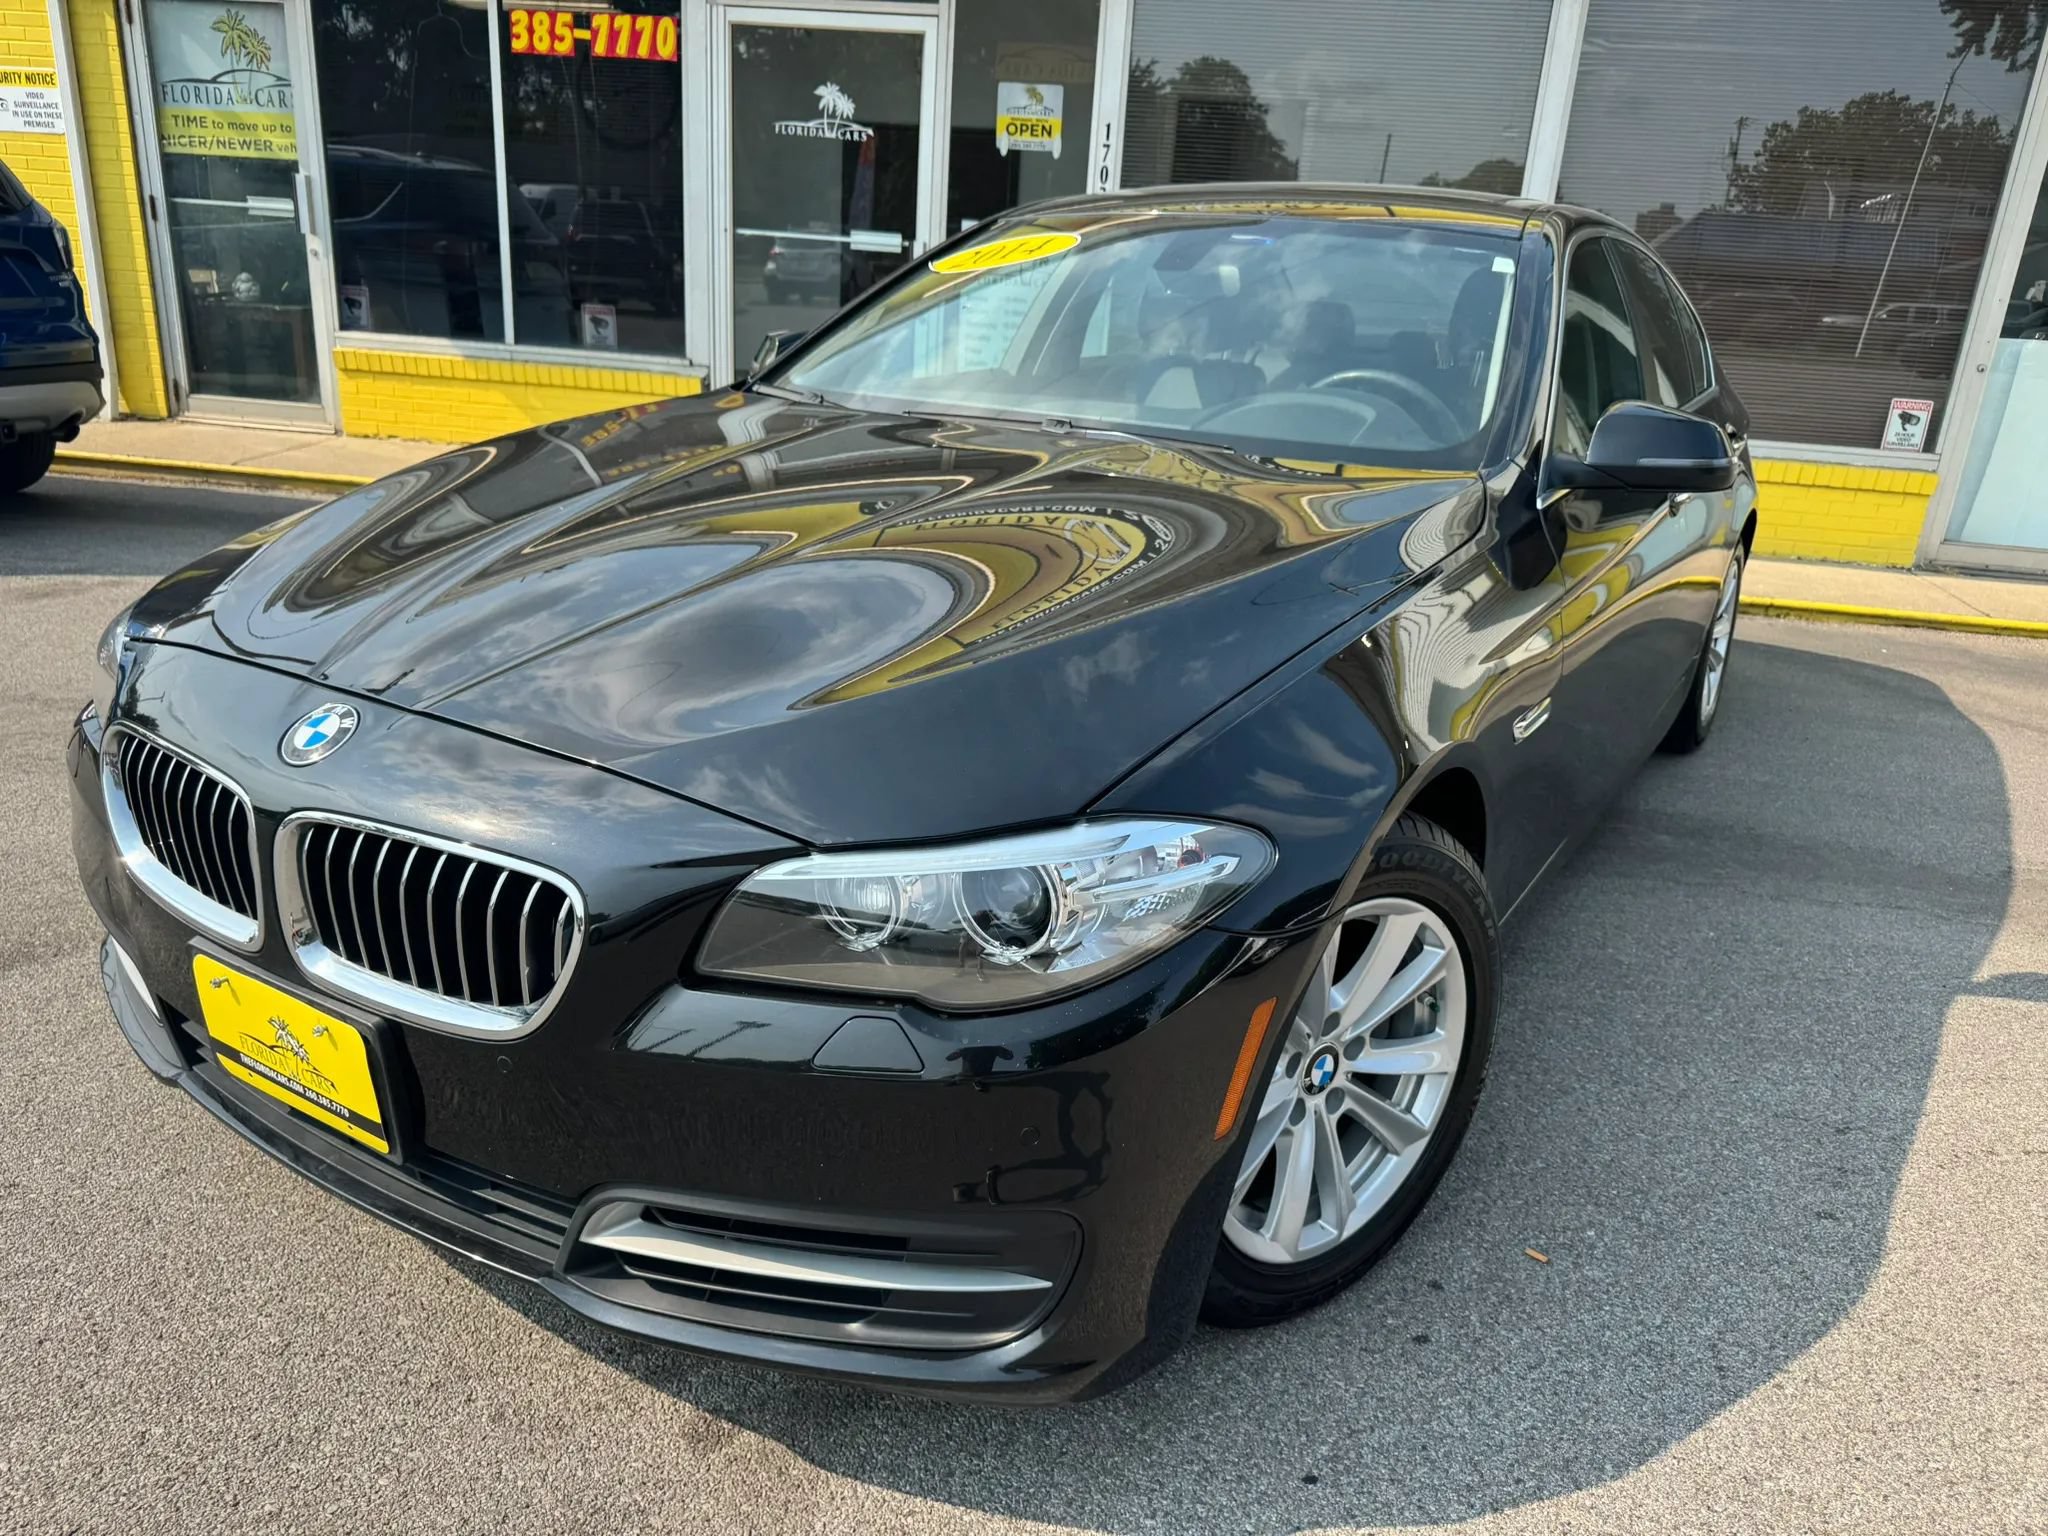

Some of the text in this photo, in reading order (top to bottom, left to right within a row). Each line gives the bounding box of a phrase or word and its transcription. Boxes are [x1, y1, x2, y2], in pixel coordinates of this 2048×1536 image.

[511, 9, 677, 60] 385-7770
[25, 72, 56, 86] NOTICE
[25, 91, 45, 100] VIDEO
[161, 83, 294, 109] FLORIDA CAR
[13, 100, 59, 110] SURVEILLANCE
[12, 110, 63, 120] IN USE ON THESE
[23, 119, 56, 129] PREMISES
[171, 114, 292, 134] TIME to move up to
[774, 123, 868, 142] FLORIDA CARS
[1006, 122, 1052, 139] OPEN
[161, 132, 273, 152] NICER/NEWER
[1893, 400, 1931, 412] WARNING
[240, 1035, 333, 1095] FLORIDA CARS
[304, 1087, 350, 1118] 260.385.7770
